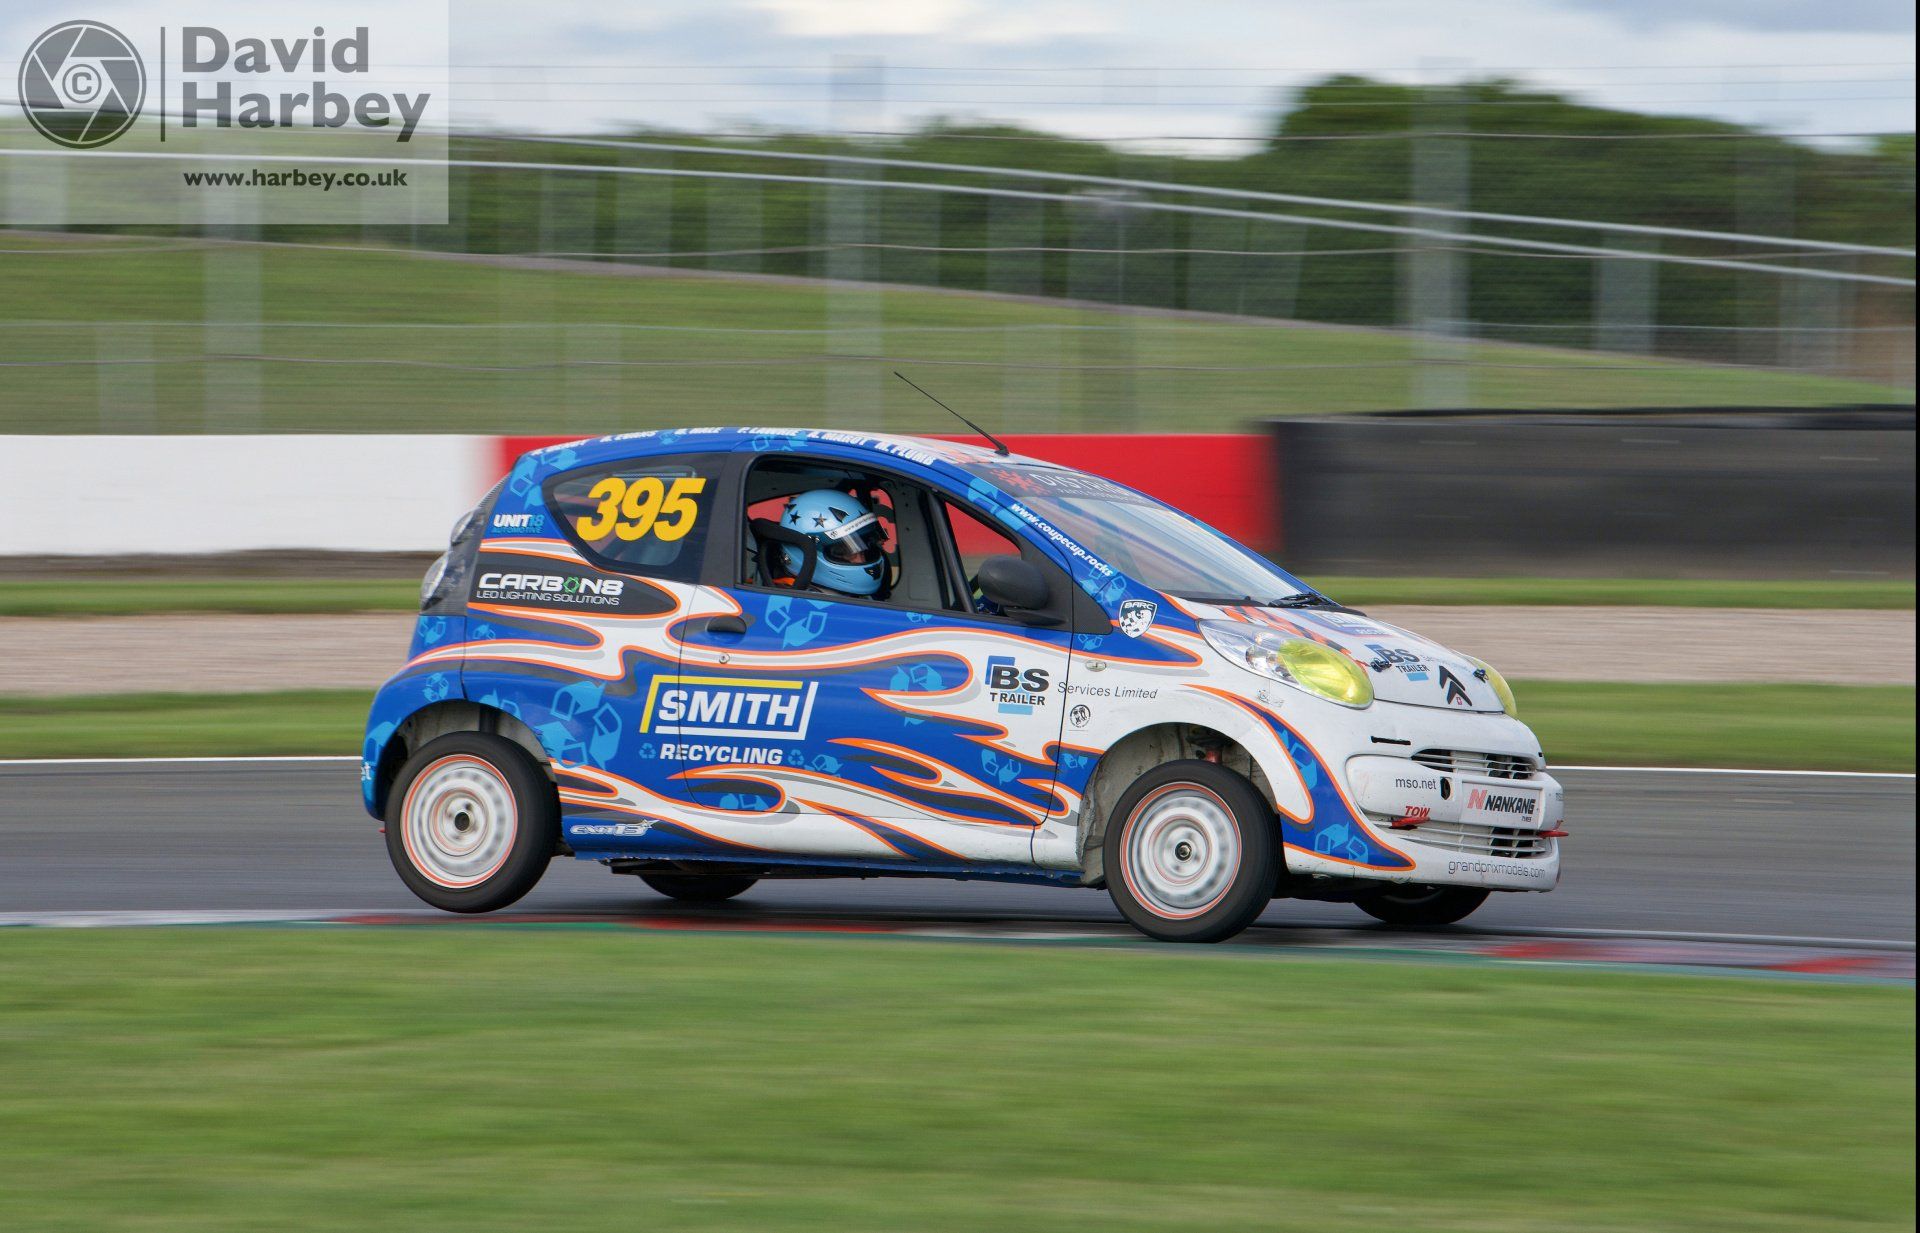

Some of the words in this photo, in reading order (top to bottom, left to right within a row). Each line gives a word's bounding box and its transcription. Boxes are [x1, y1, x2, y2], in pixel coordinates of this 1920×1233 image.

[576, 476, 707, 542] 395
[1011, 503, 1114, 577] www.coupecup.rocks
[478, 572, 624, 596] CARBON8
[476, 590, 499, 600] LED
[500, 591, 551, 602] LIGHTING
[552, 593, 620, 606] SOLUTIONS
[1124, 602, 1154, 610] BARC
[1395, 662, 1431, 673] TRAILER
[990, 665, 1050, 693] BS
[989, 691, 1046, 706] TRAILER
[1057, 681, 1111, 697] Services
[1114, 686, 1158, 699] Limited
[658, 689, 800, 727] SMITH
[659, 743, 783, 765] RECYCLING
[1395, 777, 1437, 790] mso.net
[1405, 805, 1431, 818] TOW
[1484, 794, 1537, 815] NANKANG
[1448, 860, 1546, 879] grandprixmodels.com
